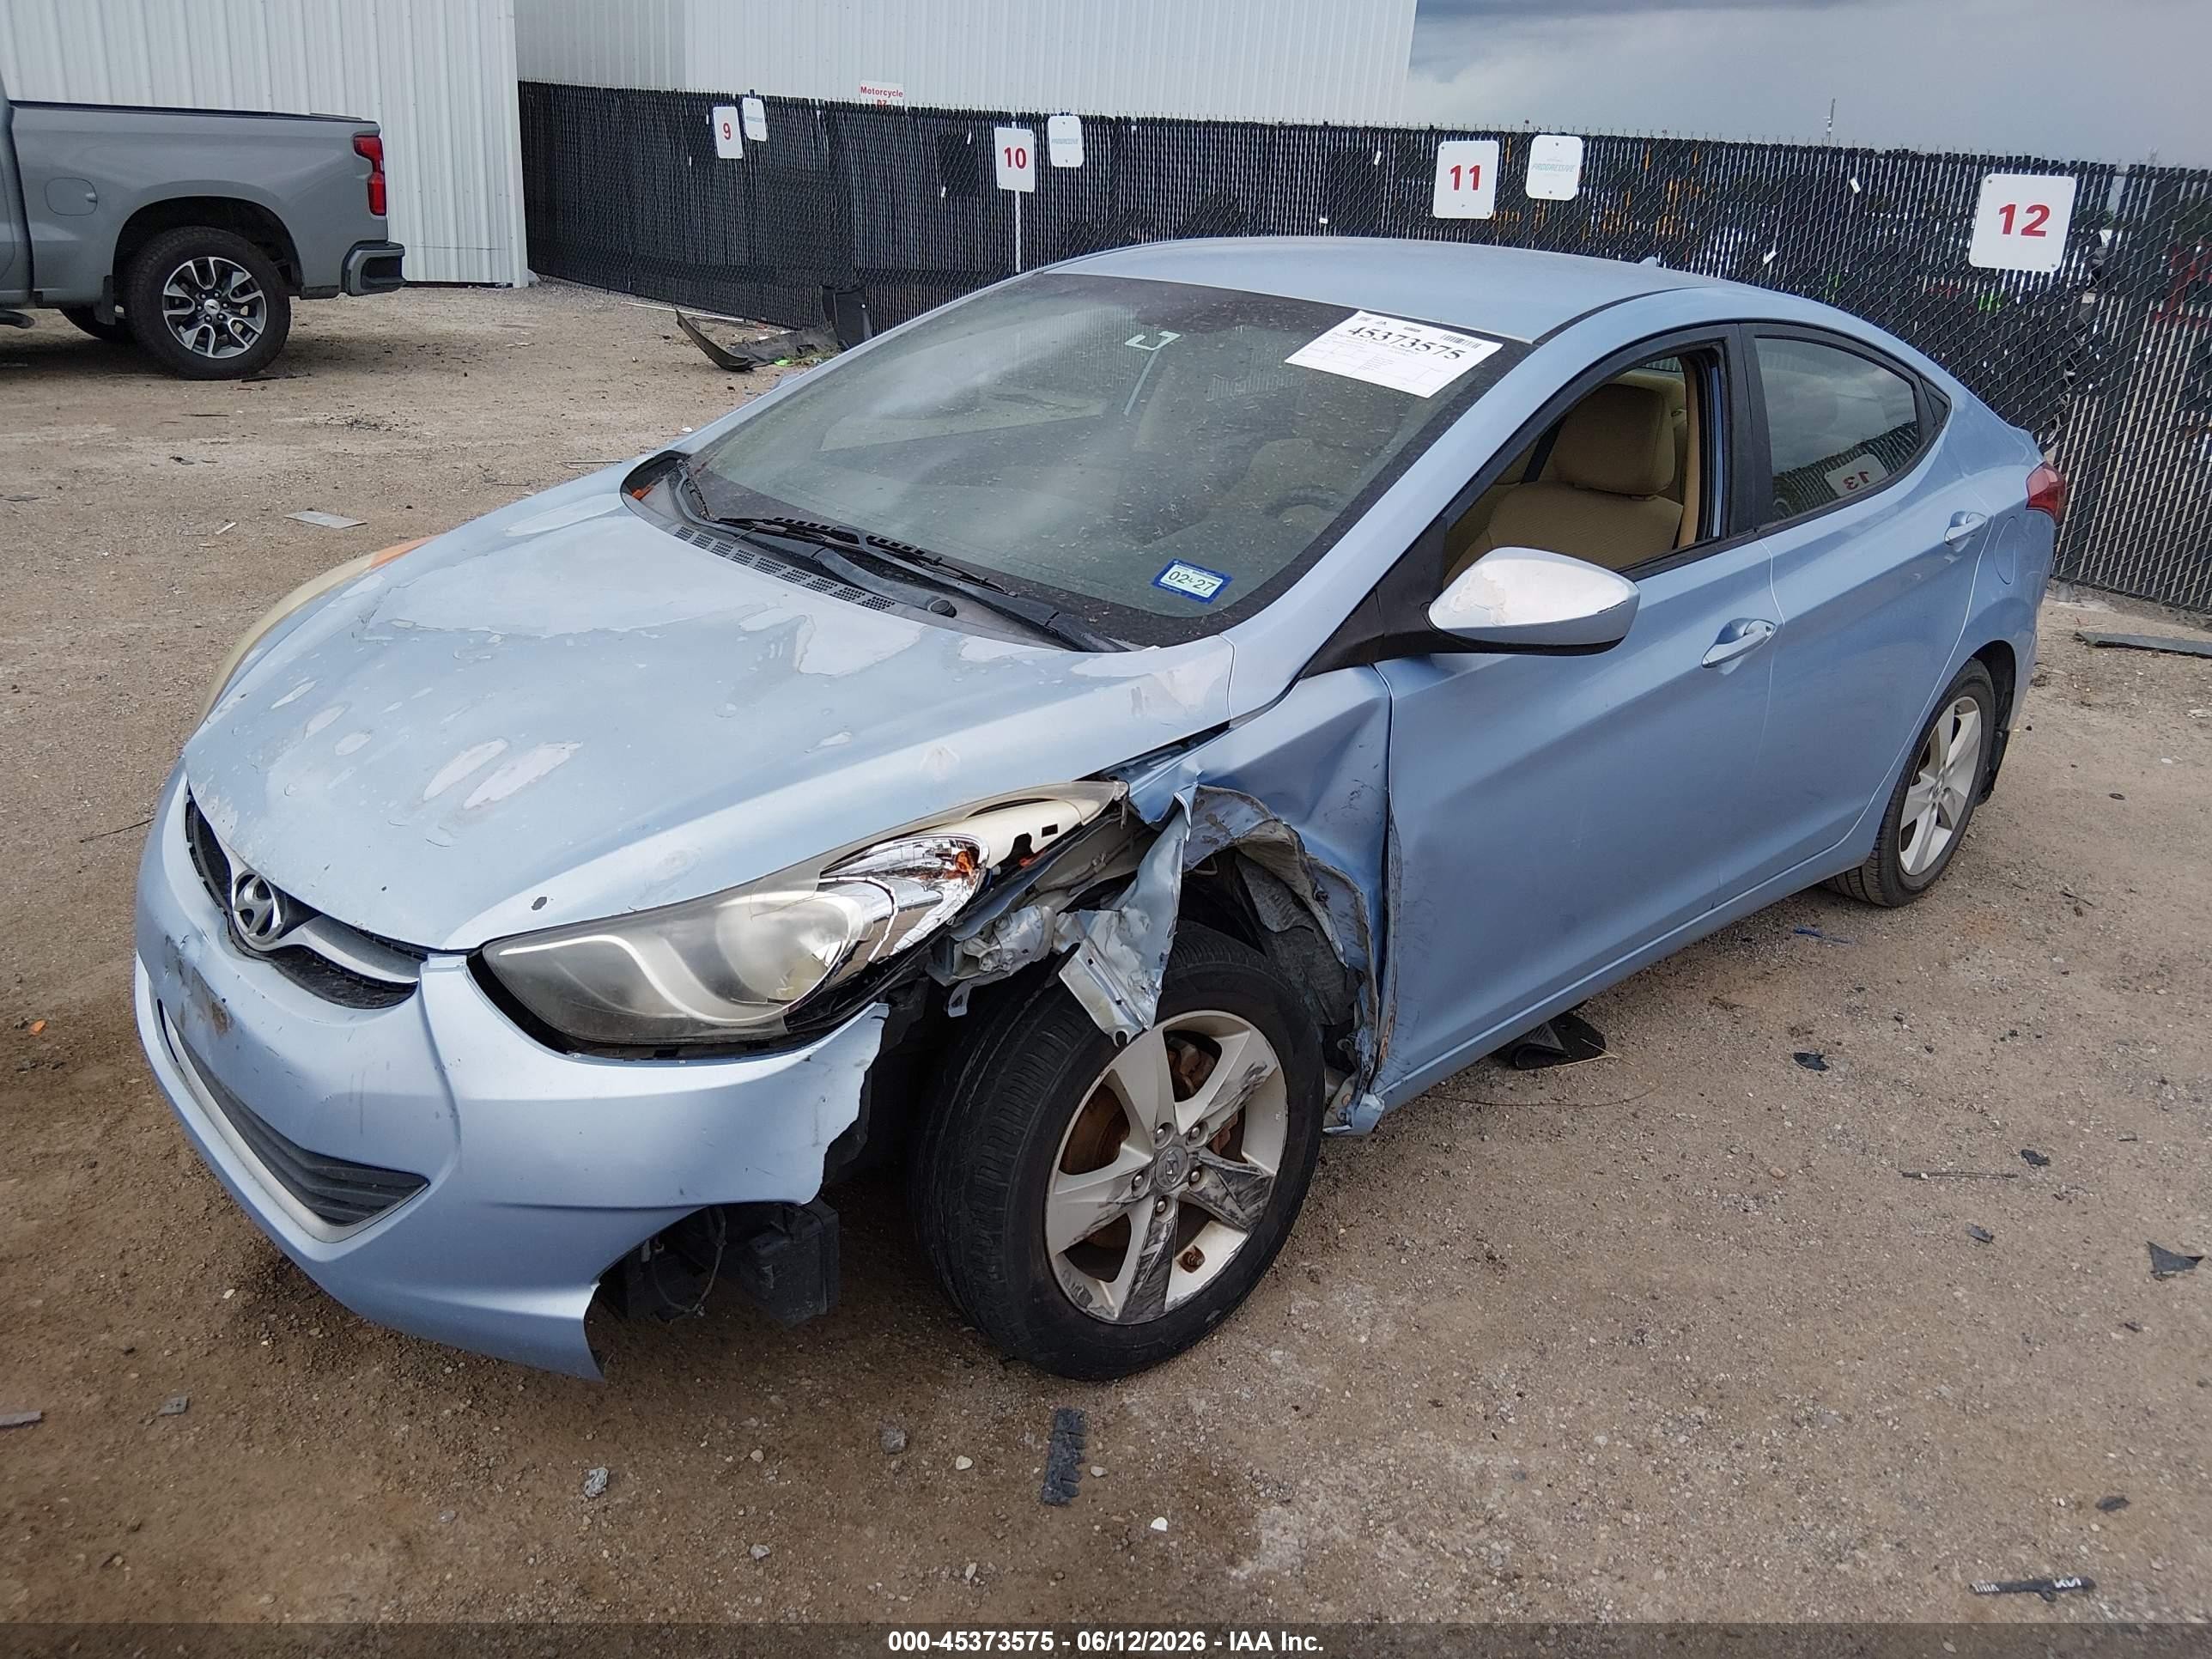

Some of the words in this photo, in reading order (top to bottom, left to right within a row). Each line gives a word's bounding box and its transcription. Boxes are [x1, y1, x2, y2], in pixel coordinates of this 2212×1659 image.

[860, 86, 903, 98] Motorcycle
[722, 122, 732, 141] 9
[1004, 146, 1027, 170] 10
[1450, 164, 1481, 191] 11
[1998, 204, 2051, 238] 12
[1347, 326, 1468, 361] 45373575
